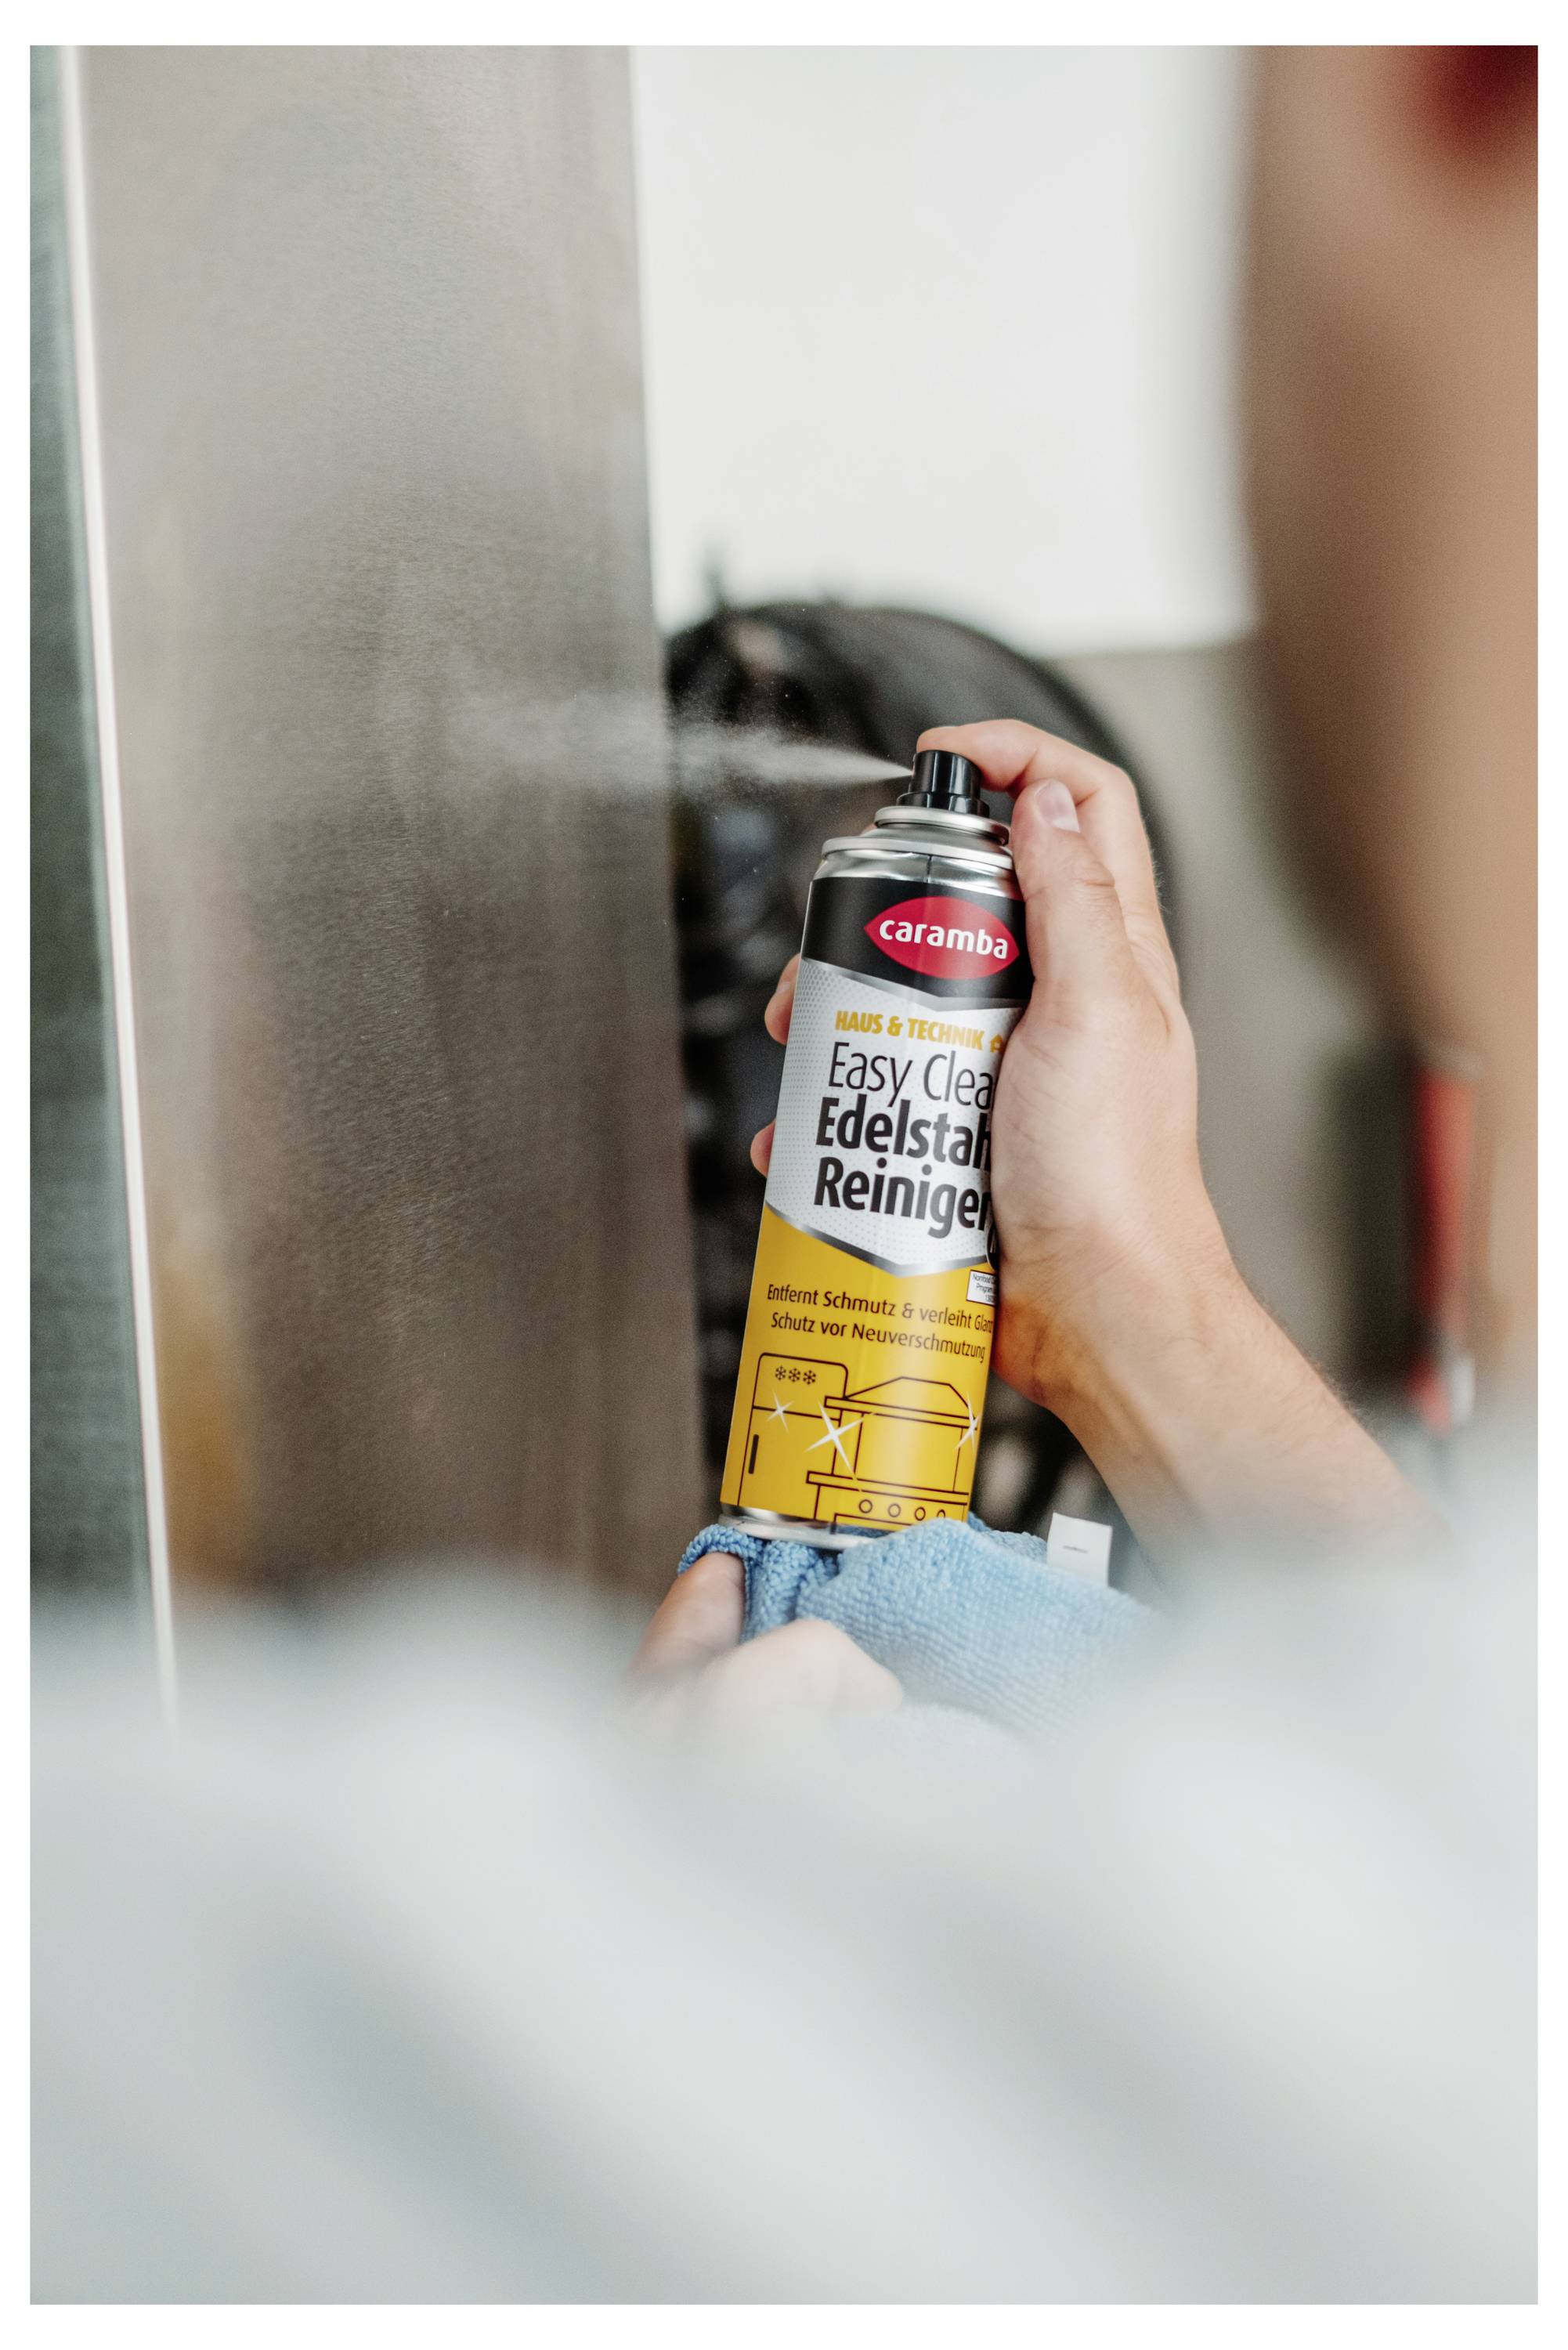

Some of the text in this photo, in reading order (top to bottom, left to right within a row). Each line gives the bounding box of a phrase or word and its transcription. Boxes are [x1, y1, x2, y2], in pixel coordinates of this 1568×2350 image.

[879, 920, 1009, 960] caramba
[834, 1010, 985, 1050] HAUS & TECHNIK
[828, 1041, 993, 1110] Easy Clea
[815, 1093, 992, 1173] Edelstah
[814, 1156, 992, 1238] Reiniger
[767, 1284, 818, 1306] Entfernt
[822, 1291, 896, 1317] Schmutz
[901, 1302, 915, 1319] &
[919, 1307, 972, 1329] verleiht
[771, 1311, 986, 1364] Schutz vor Neuverschmutzung
